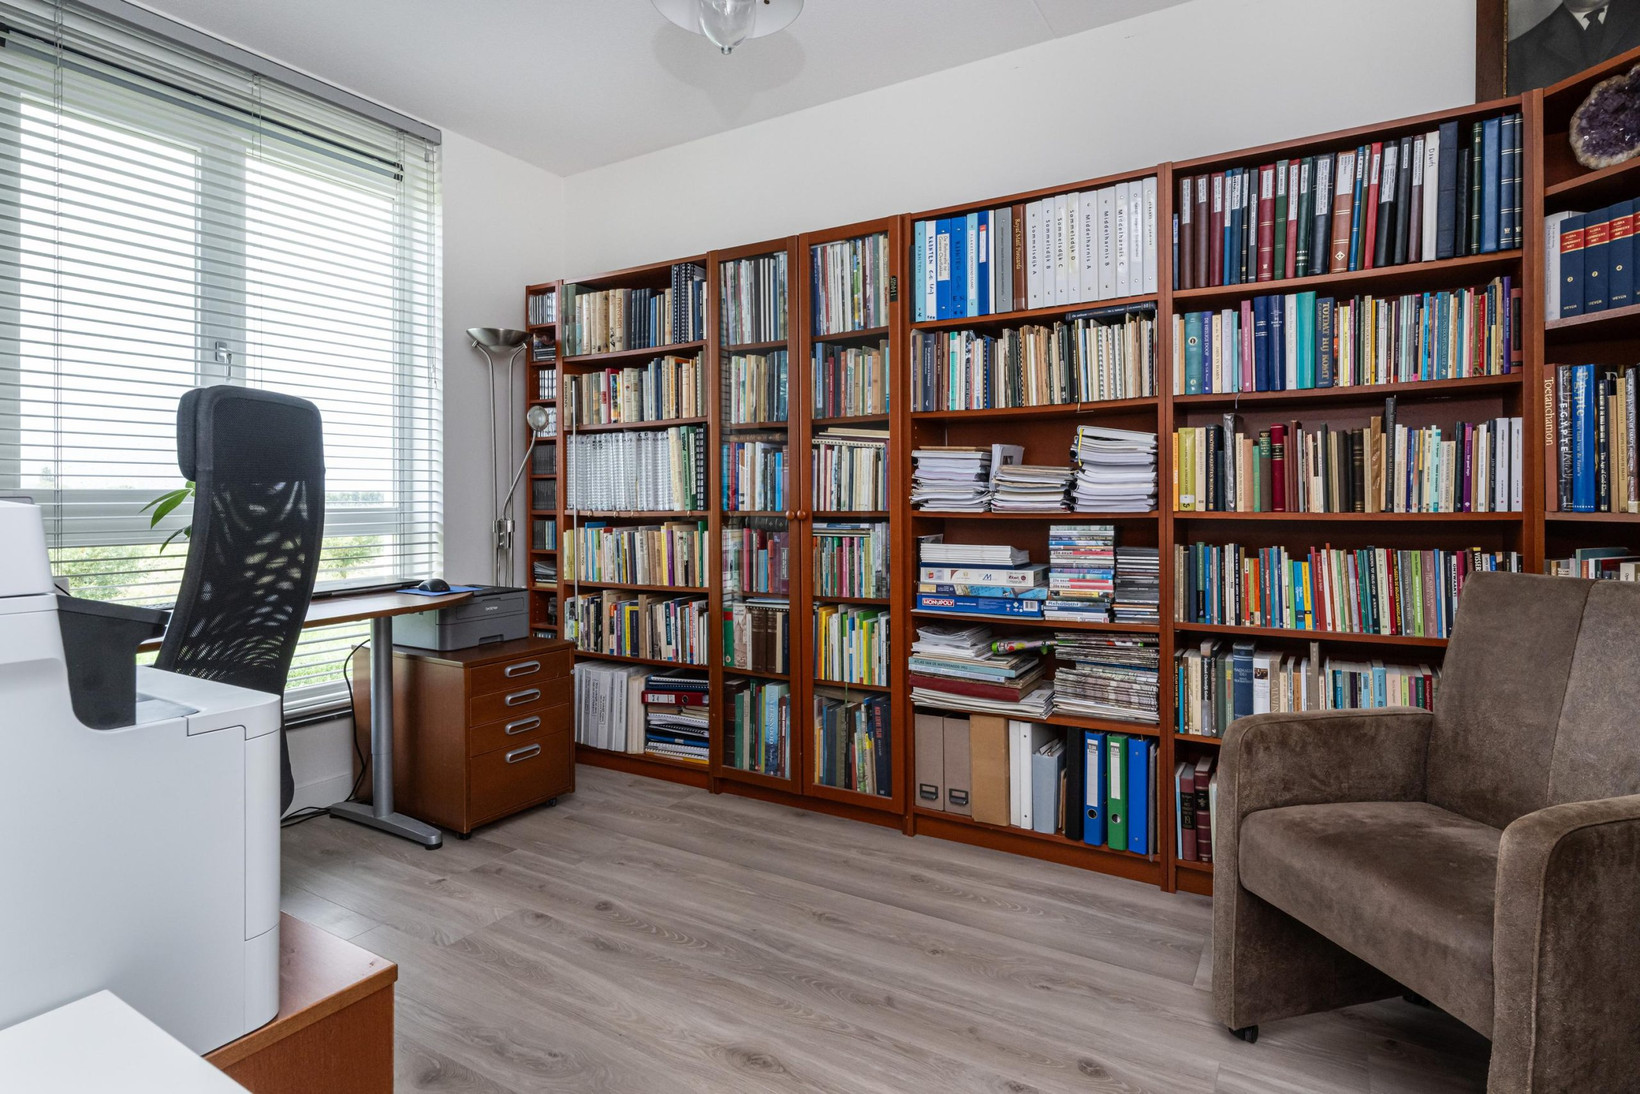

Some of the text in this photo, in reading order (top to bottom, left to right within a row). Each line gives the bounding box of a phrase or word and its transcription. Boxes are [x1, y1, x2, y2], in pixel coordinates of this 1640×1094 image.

[1320, 337, 1330, 352] HIJ
[1544, 376, 1555, 446] Toetanchamon
[1574, 371, 1588, 417] Egypte
[1559, 403, 1569, 452] EGYPTE
[923, 599, 954, 607] MONOPOLY
